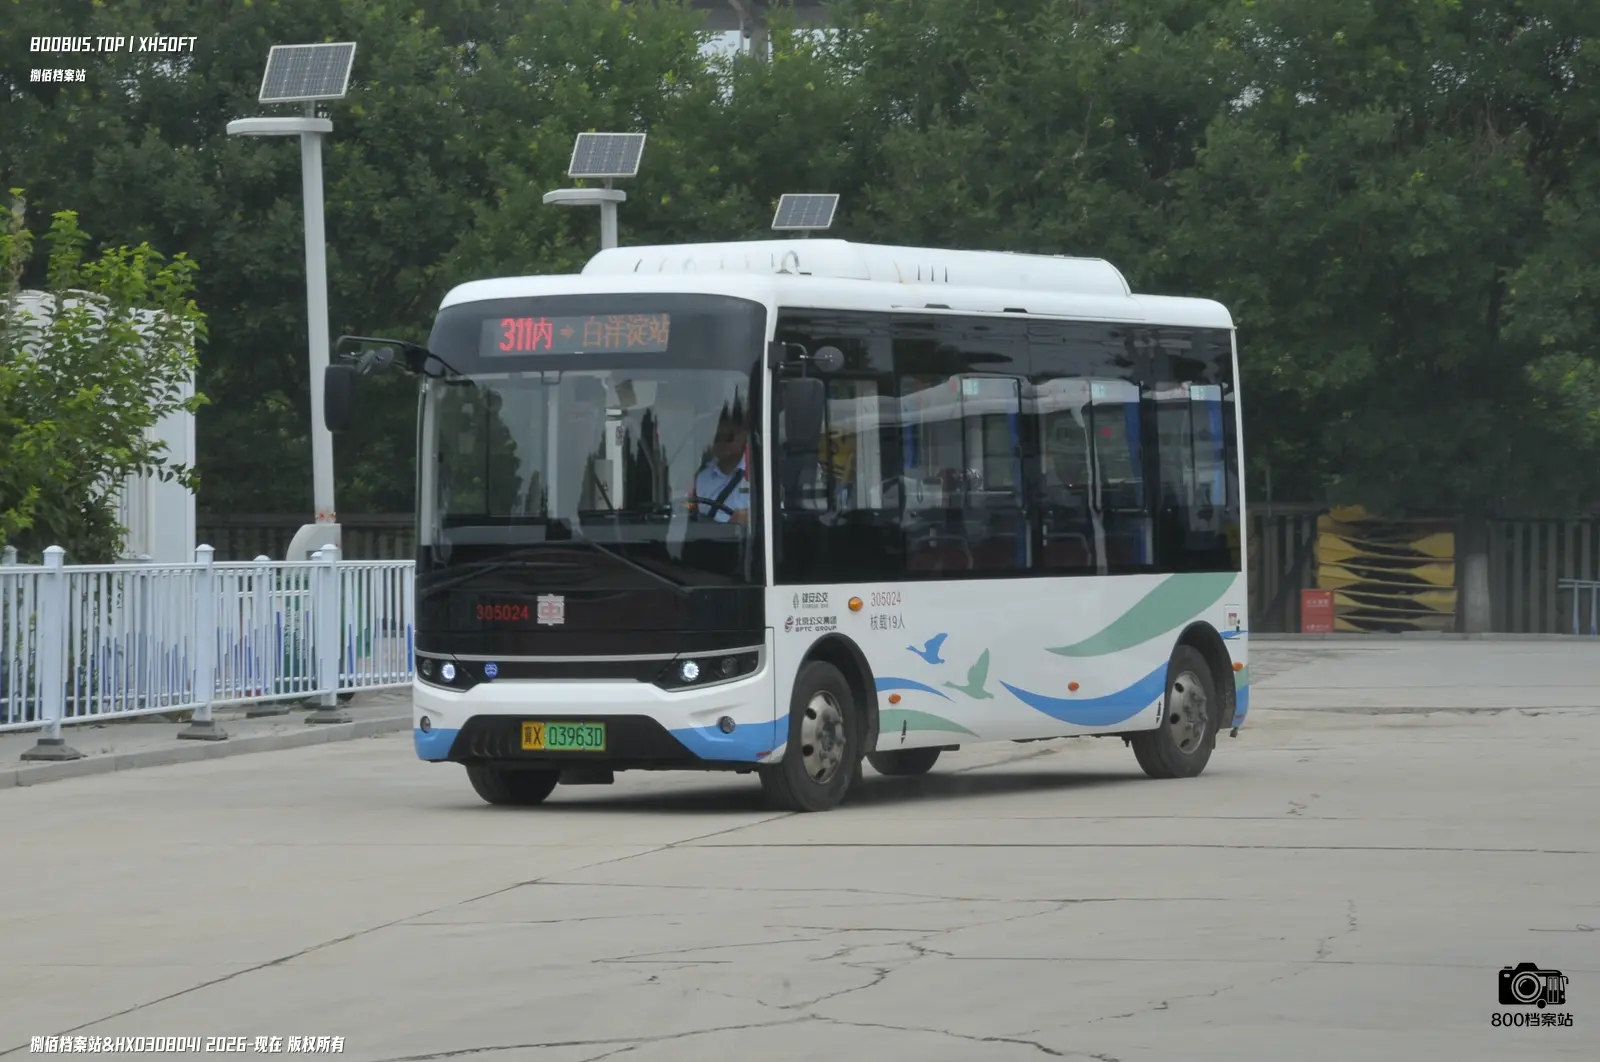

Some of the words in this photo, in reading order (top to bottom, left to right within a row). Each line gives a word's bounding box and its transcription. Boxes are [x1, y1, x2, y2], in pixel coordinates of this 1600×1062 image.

[500, 317, 553, 351] 311内
[870, 592, 902, 607] 305024
[476, 603, 529, 620] 305024
[870, 613, 905, 631] 核载19人
